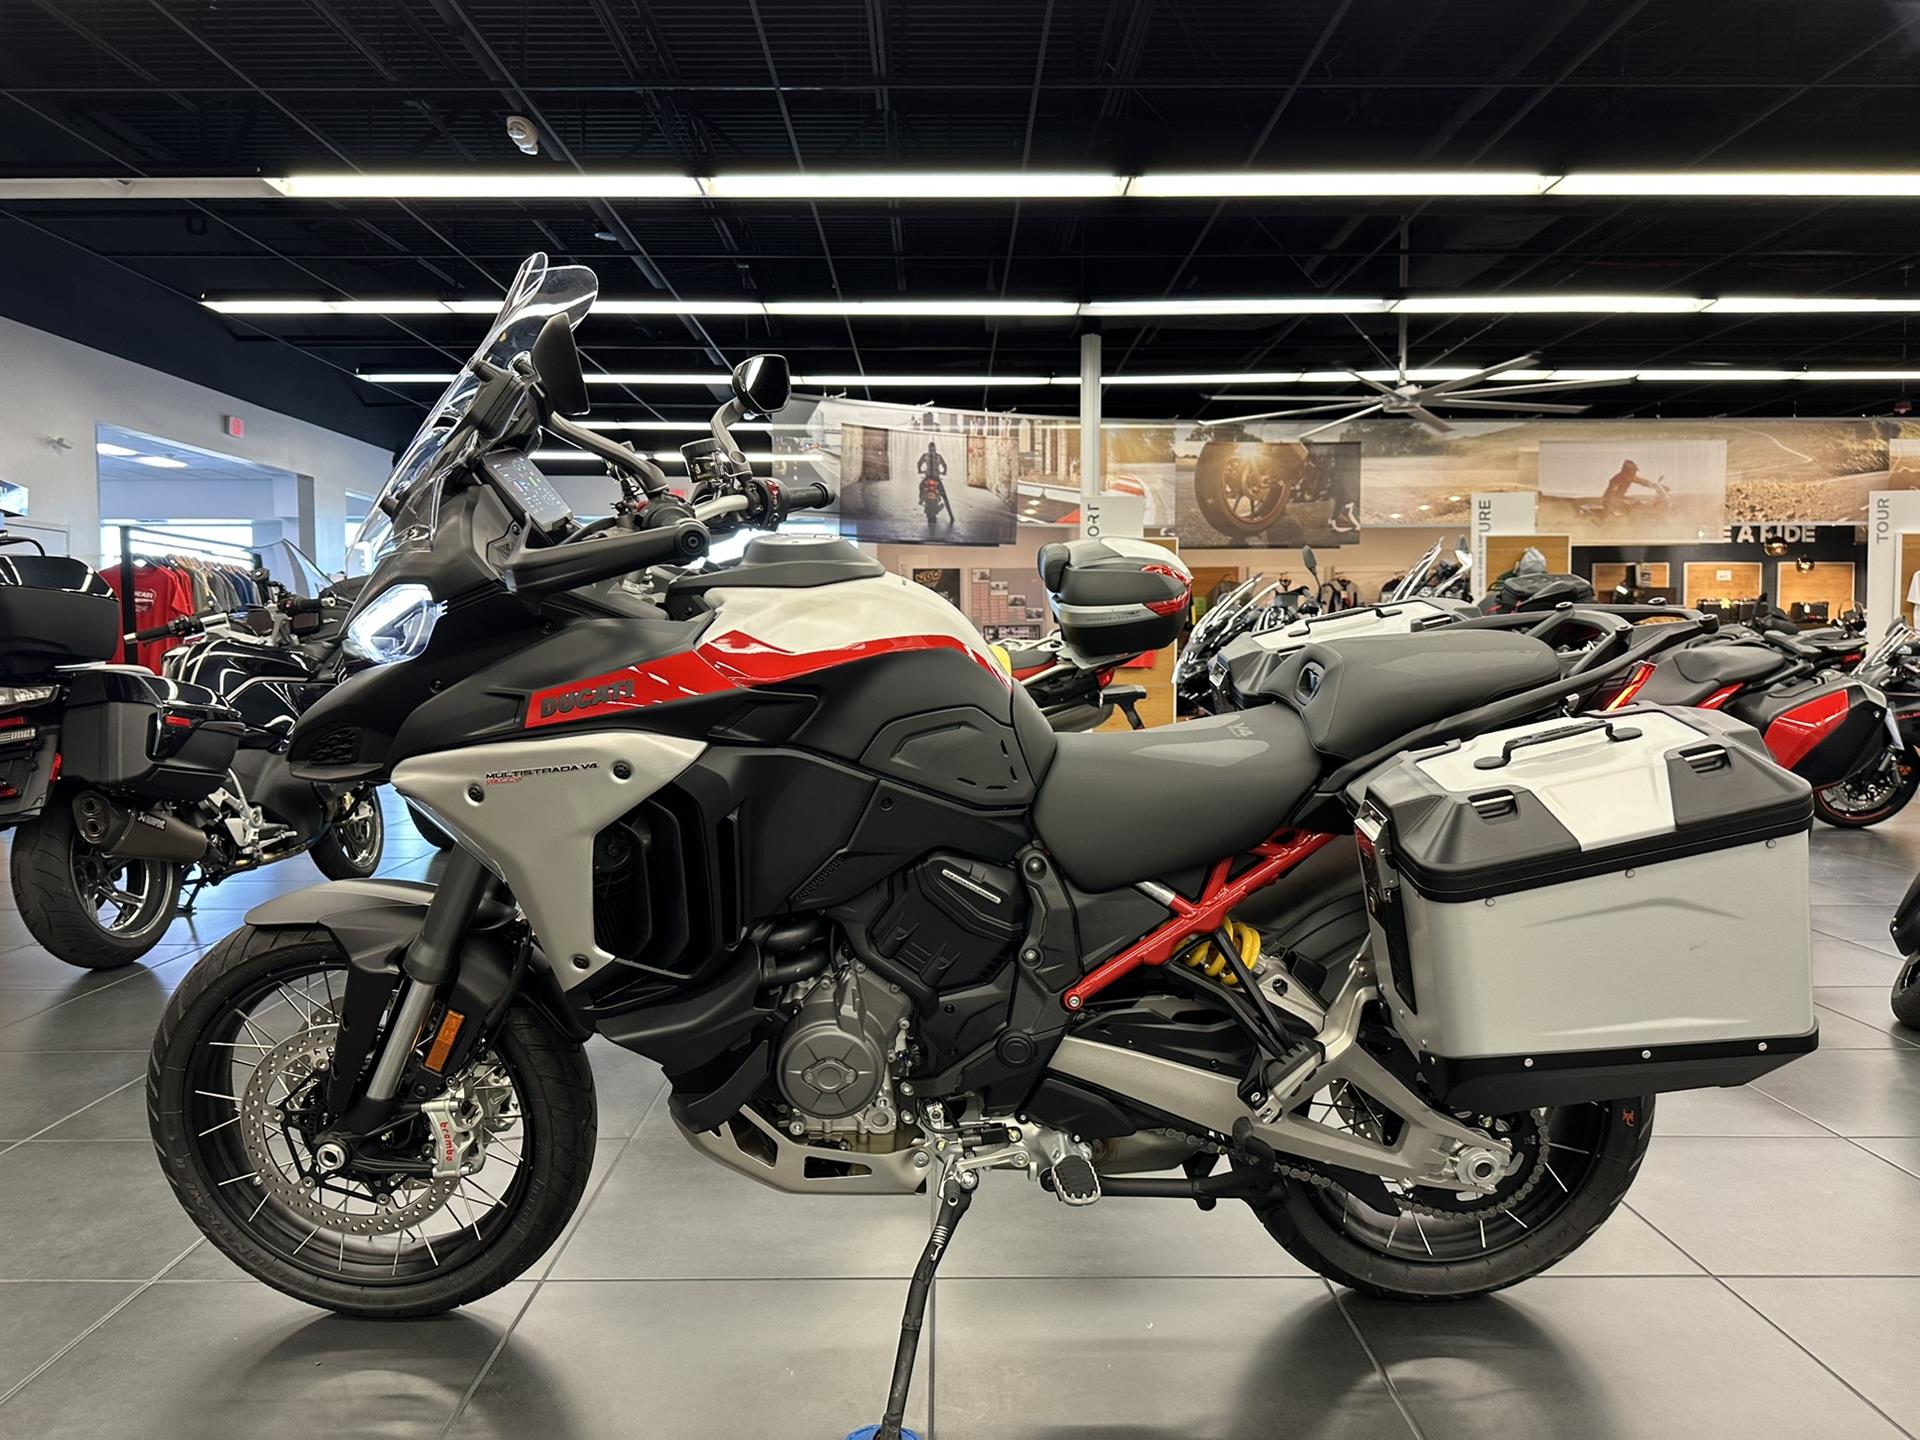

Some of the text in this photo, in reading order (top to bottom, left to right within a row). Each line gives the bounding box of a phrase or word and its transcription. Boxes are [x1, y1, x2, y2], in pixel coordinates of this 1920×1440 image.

[1736, 525, 1755, 543] A
[1761, 525, 1816, 543] RIDE
[1876, 498, 1889, 544] TOUR
[540, 680, 635, 719] DUCATI
[486, 762, 599, 780] MULTISTRADA V4
[440, 1121, 455, 1162] brembo
